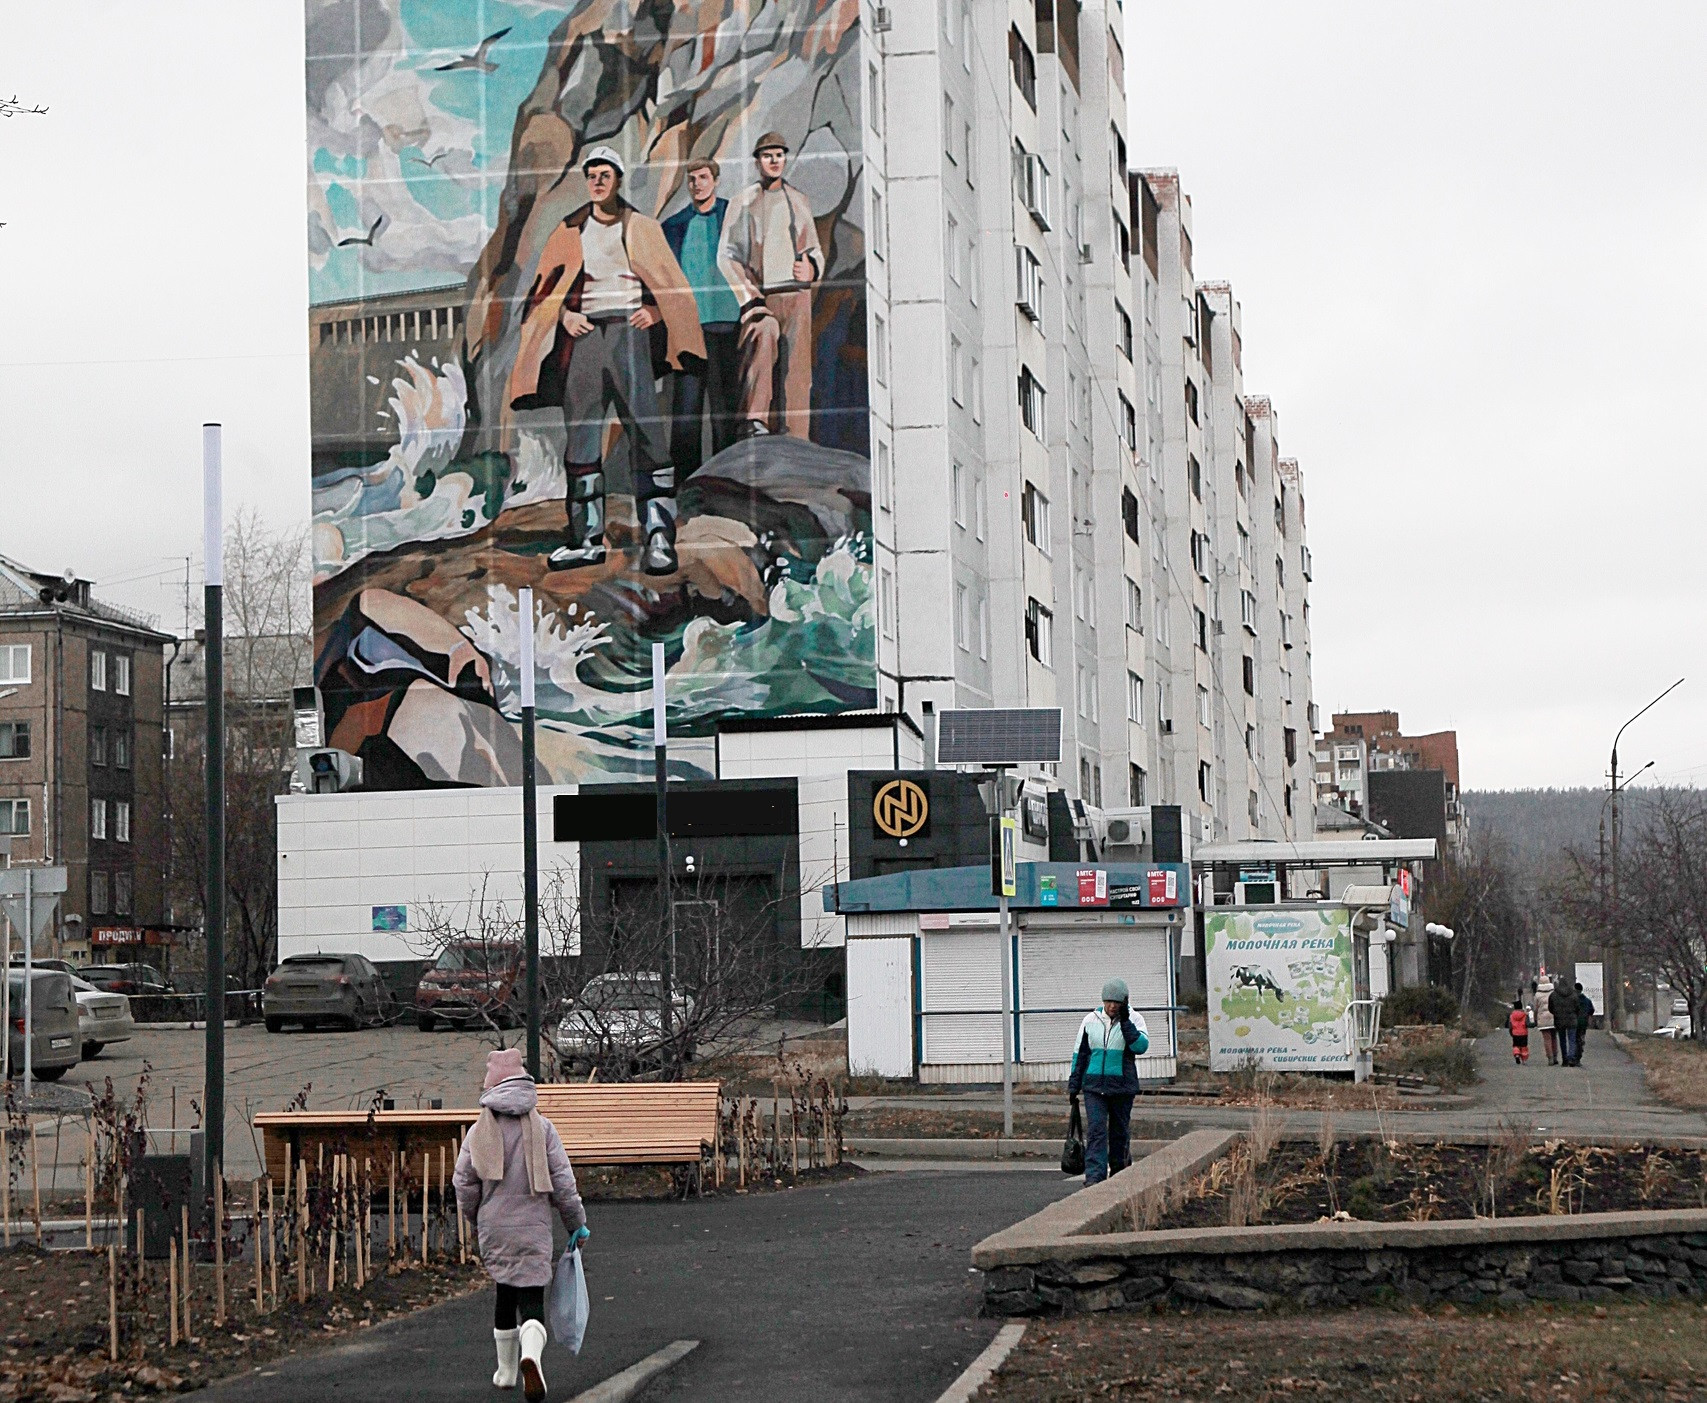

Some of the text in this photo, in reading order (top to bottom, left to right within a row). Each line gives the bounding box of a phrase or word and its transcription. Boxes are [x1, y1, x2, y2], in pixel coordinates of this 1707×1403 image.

[1226, 938, 1334, 950] МОЛОЧНАЯ РЕКА
[1273, 1054, 1349, 1063] СИБИРСКИЕ БЕРЕГА
